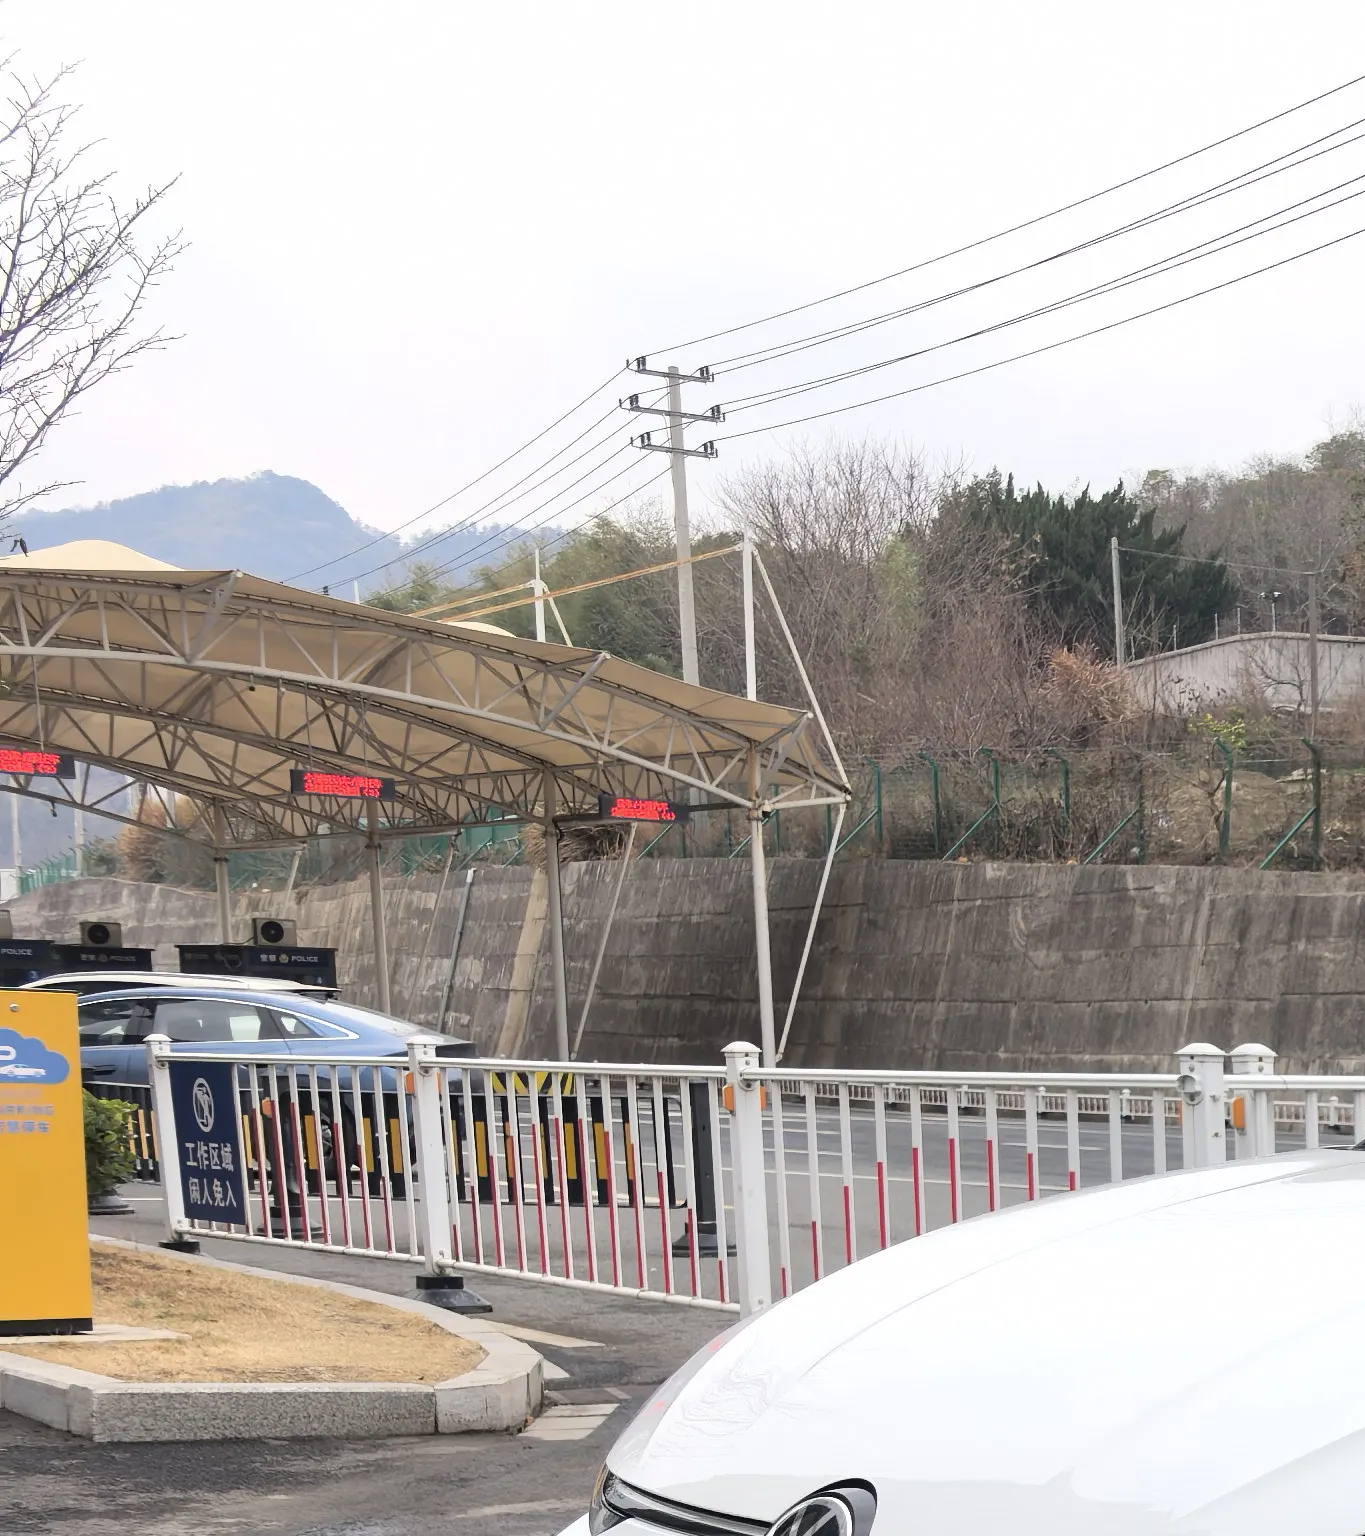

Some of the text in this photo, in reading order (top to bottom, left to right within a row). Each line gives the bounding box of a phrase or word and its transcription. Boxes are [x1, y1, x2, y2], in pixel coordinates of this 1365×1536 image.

[291, 955, 319, 963] POLICE
[185, 1141, 234, 1172] 工作区域
[189, 1176, 236, 1207] 闲人免入
